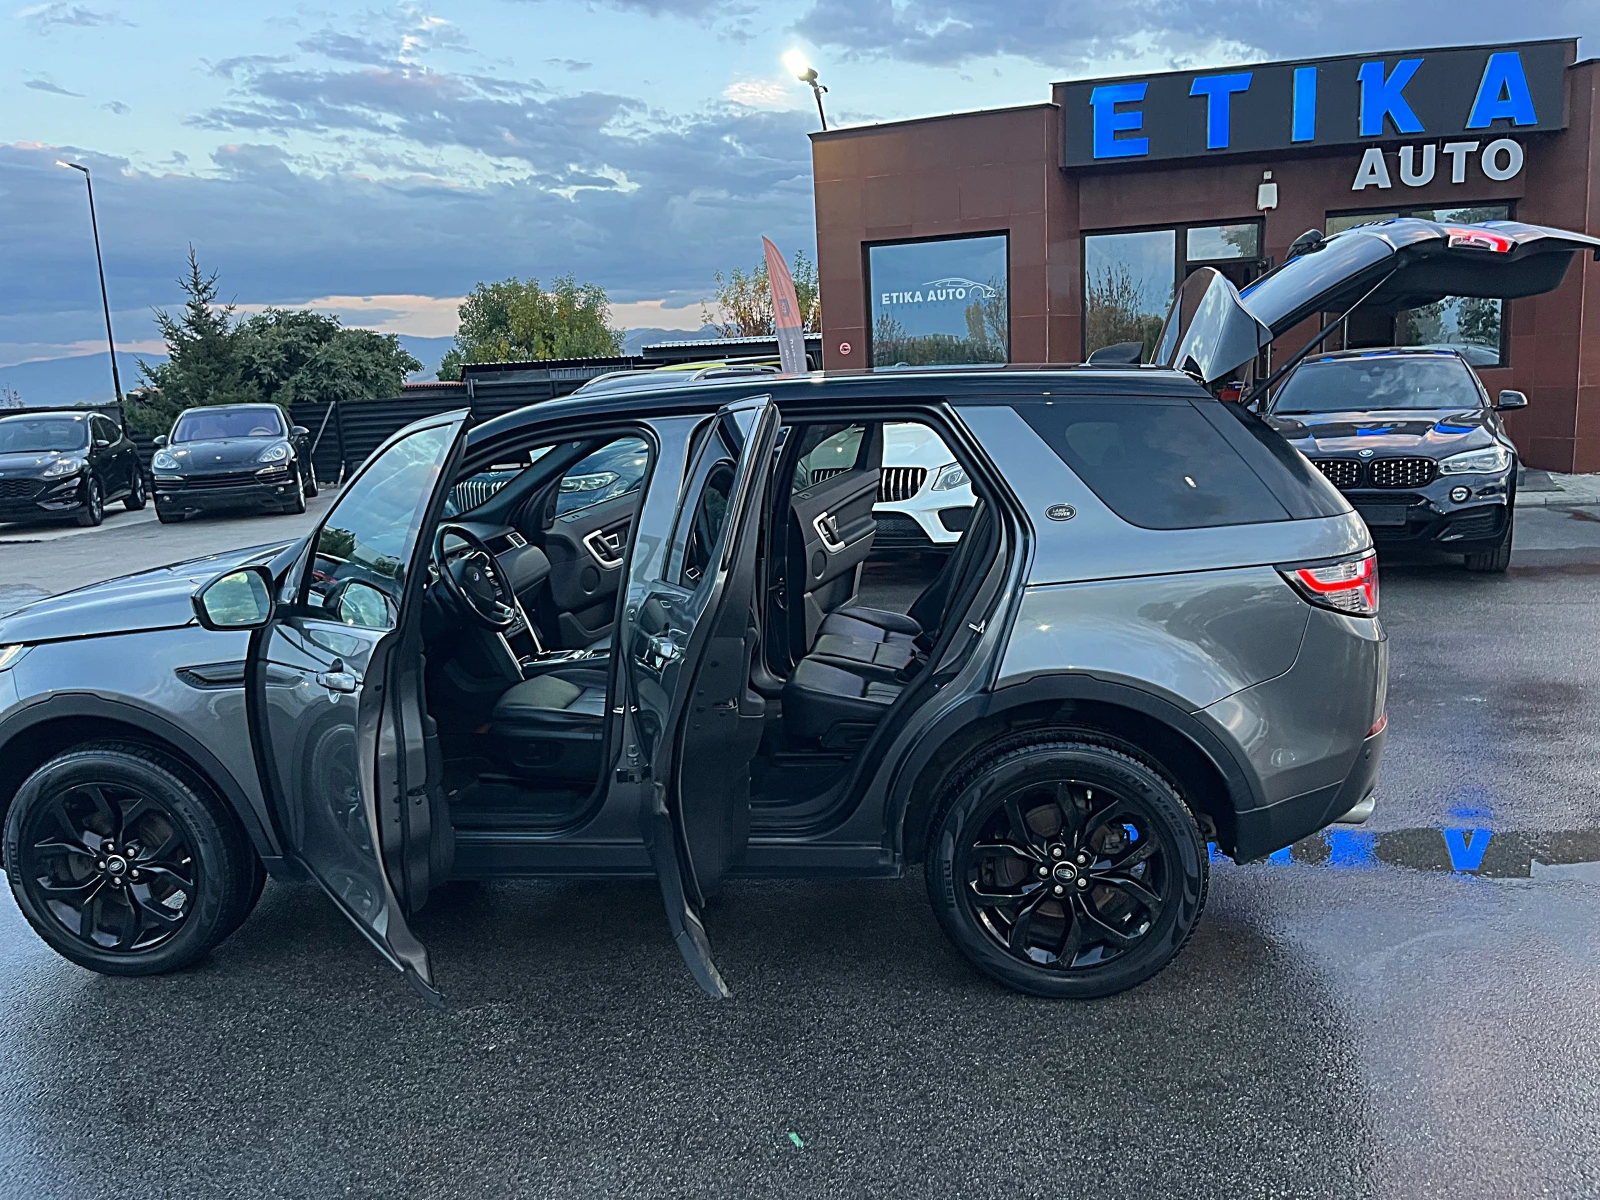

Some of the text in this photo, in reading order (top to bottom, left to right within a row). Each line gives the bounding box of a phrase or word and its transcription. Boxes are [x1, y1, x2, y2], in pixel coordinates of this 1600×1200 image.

[1089, 51, 1538, 160] ETIKA
[1352, 138, 1524, 191] AUTO
[881, 288, 966, 305] ETIKA AUTO
[943, 859, 956, 909] PIRELLI
